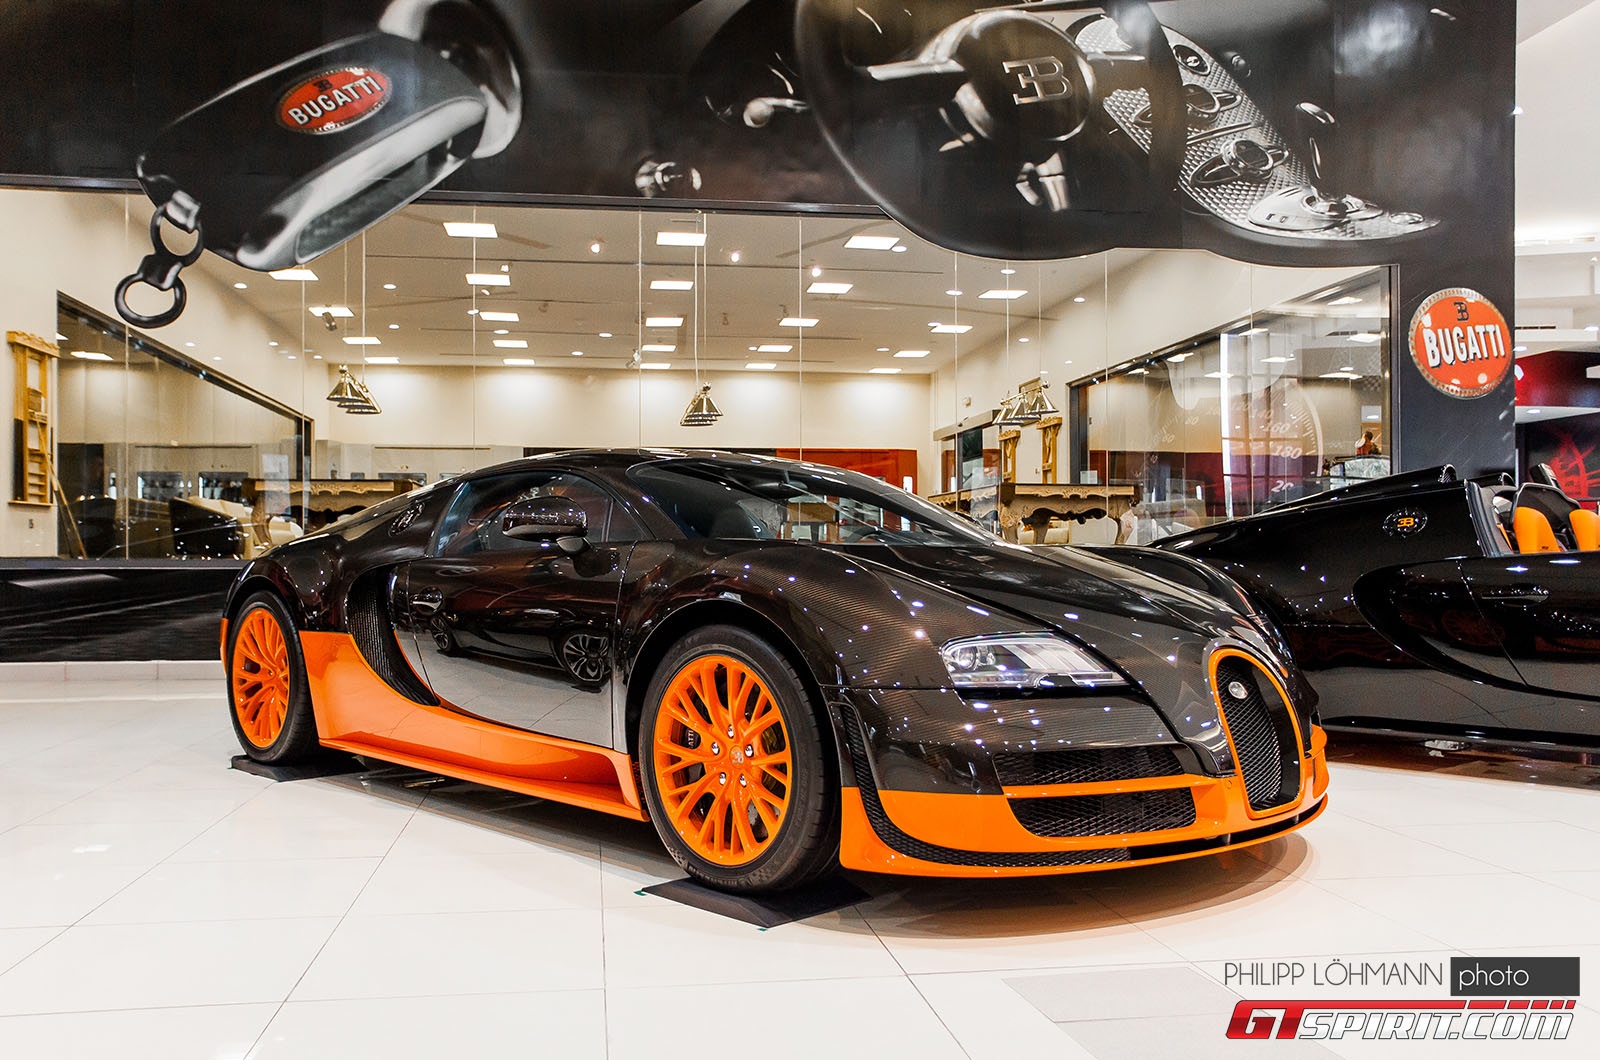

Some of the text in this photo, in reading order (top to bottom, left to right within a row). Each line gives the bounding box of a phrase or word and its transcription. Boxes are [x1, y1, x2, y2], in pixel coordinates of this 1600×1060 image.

[287, 75, 384, 126] BUGATTI
[1422, 323, 1506, 369] BUGATTI
[1271, 445, 1303, 460] 180
[687, 729, 695, 747] ATTI
